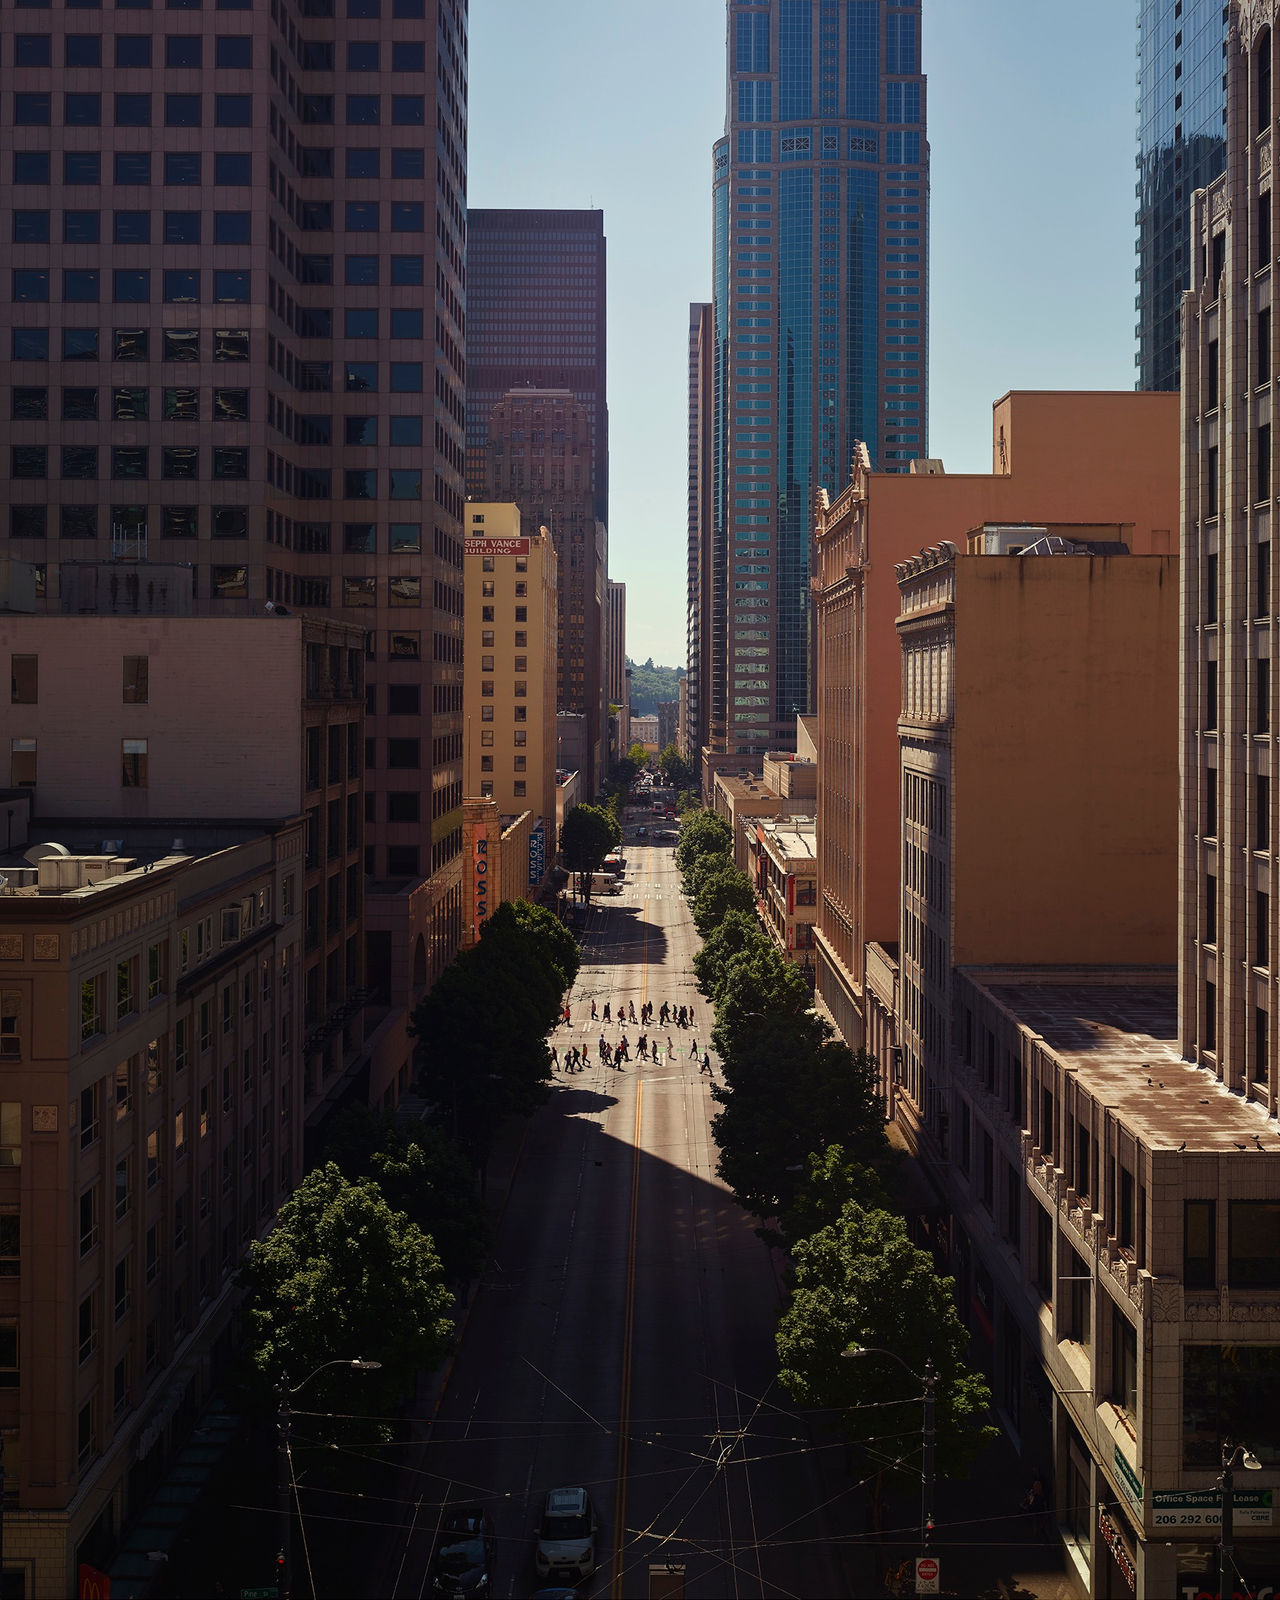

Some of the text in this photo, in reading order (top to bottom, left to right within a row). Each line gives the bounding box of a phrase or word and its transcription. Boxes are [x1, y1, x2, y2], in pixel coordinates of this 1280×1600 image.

[530, 840, 538, 879] ROSS
[476, 839, 488, 916] ROSS
[1155, 1494, 1182, 1503] Office
[1186, 1494, 1213, 1504] Space
[1233, 1494, 1260, 1502] Lease
[1155, 1515, 1177, 1524] 206
[1180, 1515, 1201, 1524] 292
